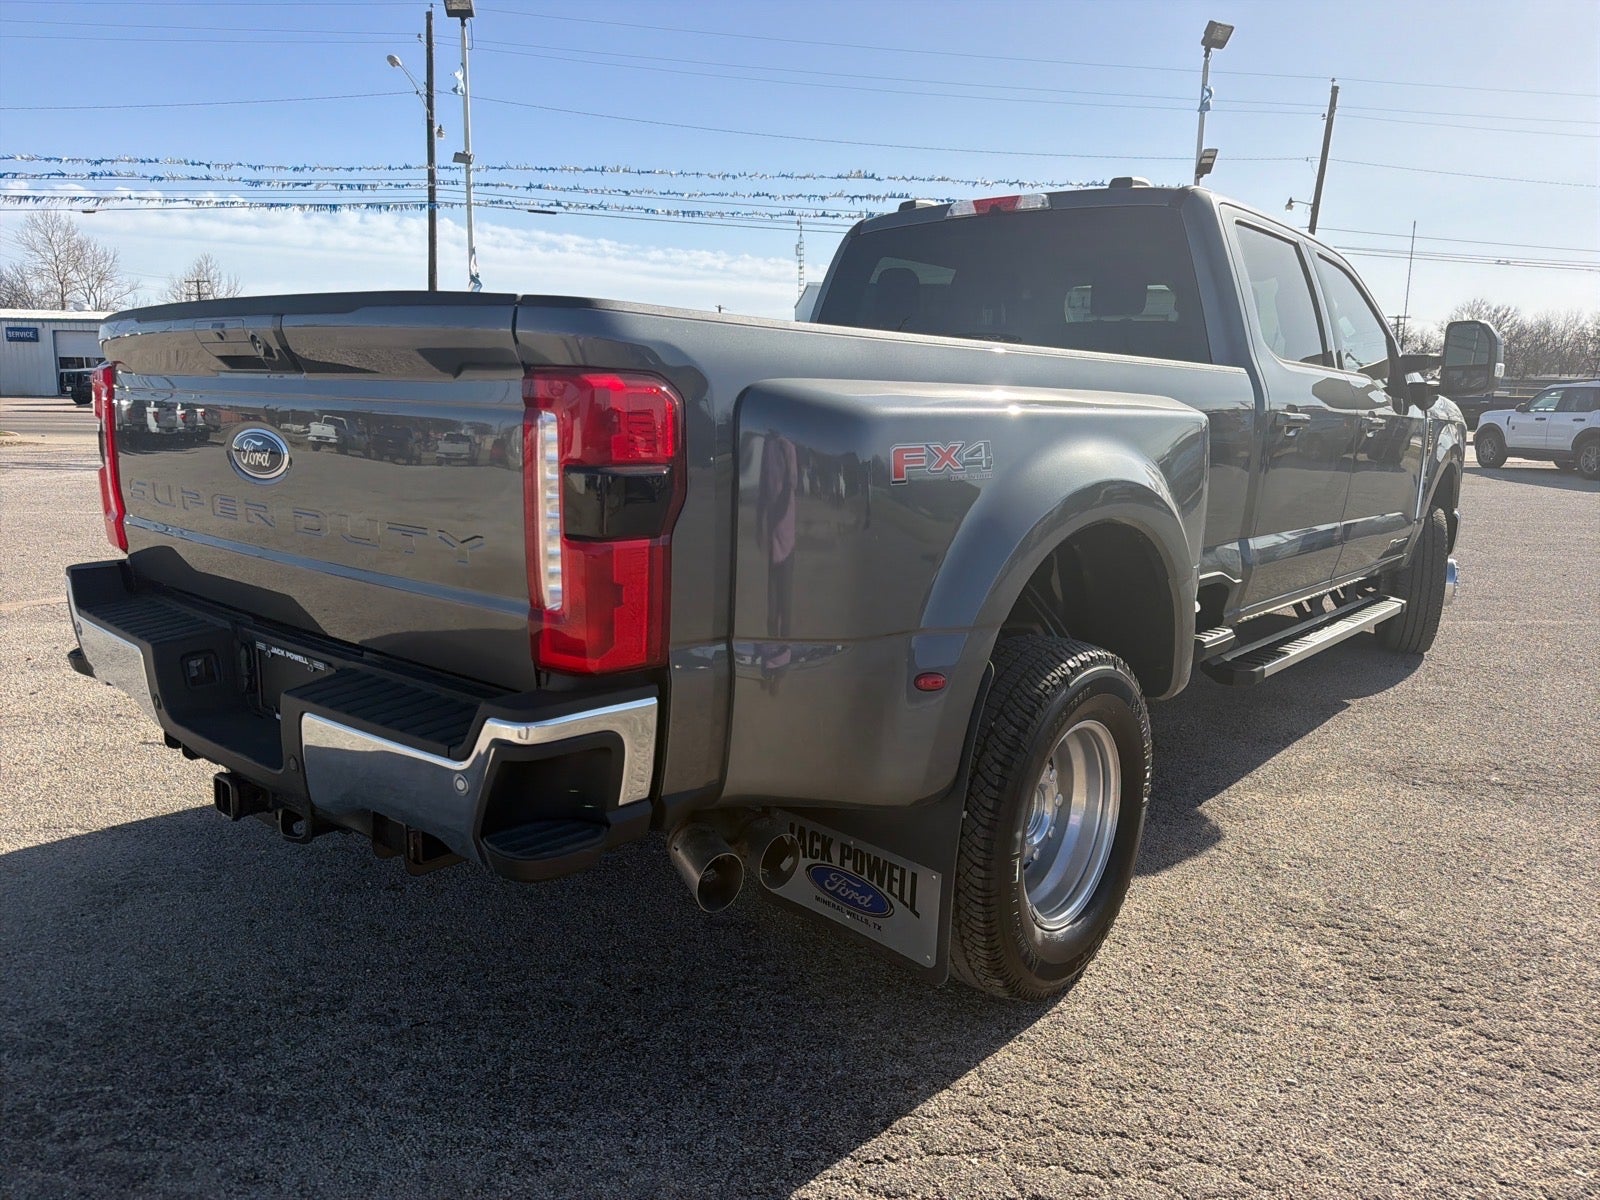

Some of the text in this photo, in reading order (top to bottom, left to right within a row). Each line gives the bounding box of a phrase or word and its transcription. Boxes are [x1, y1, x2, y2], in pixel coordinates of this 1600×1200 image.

[241, 438, 271, 467] Ford
[890, 440, 993, 485] FX4
[129, 478, 485, 564] SUPER DUTY
[270, 646, 309, 665] JACK POWELL
[824, 872, 873, 908] Ford
[839, 841, 921, 919] POWELL
[814, 895, 846, 914] MINERAL
[872, 922, 883, 932] TX
